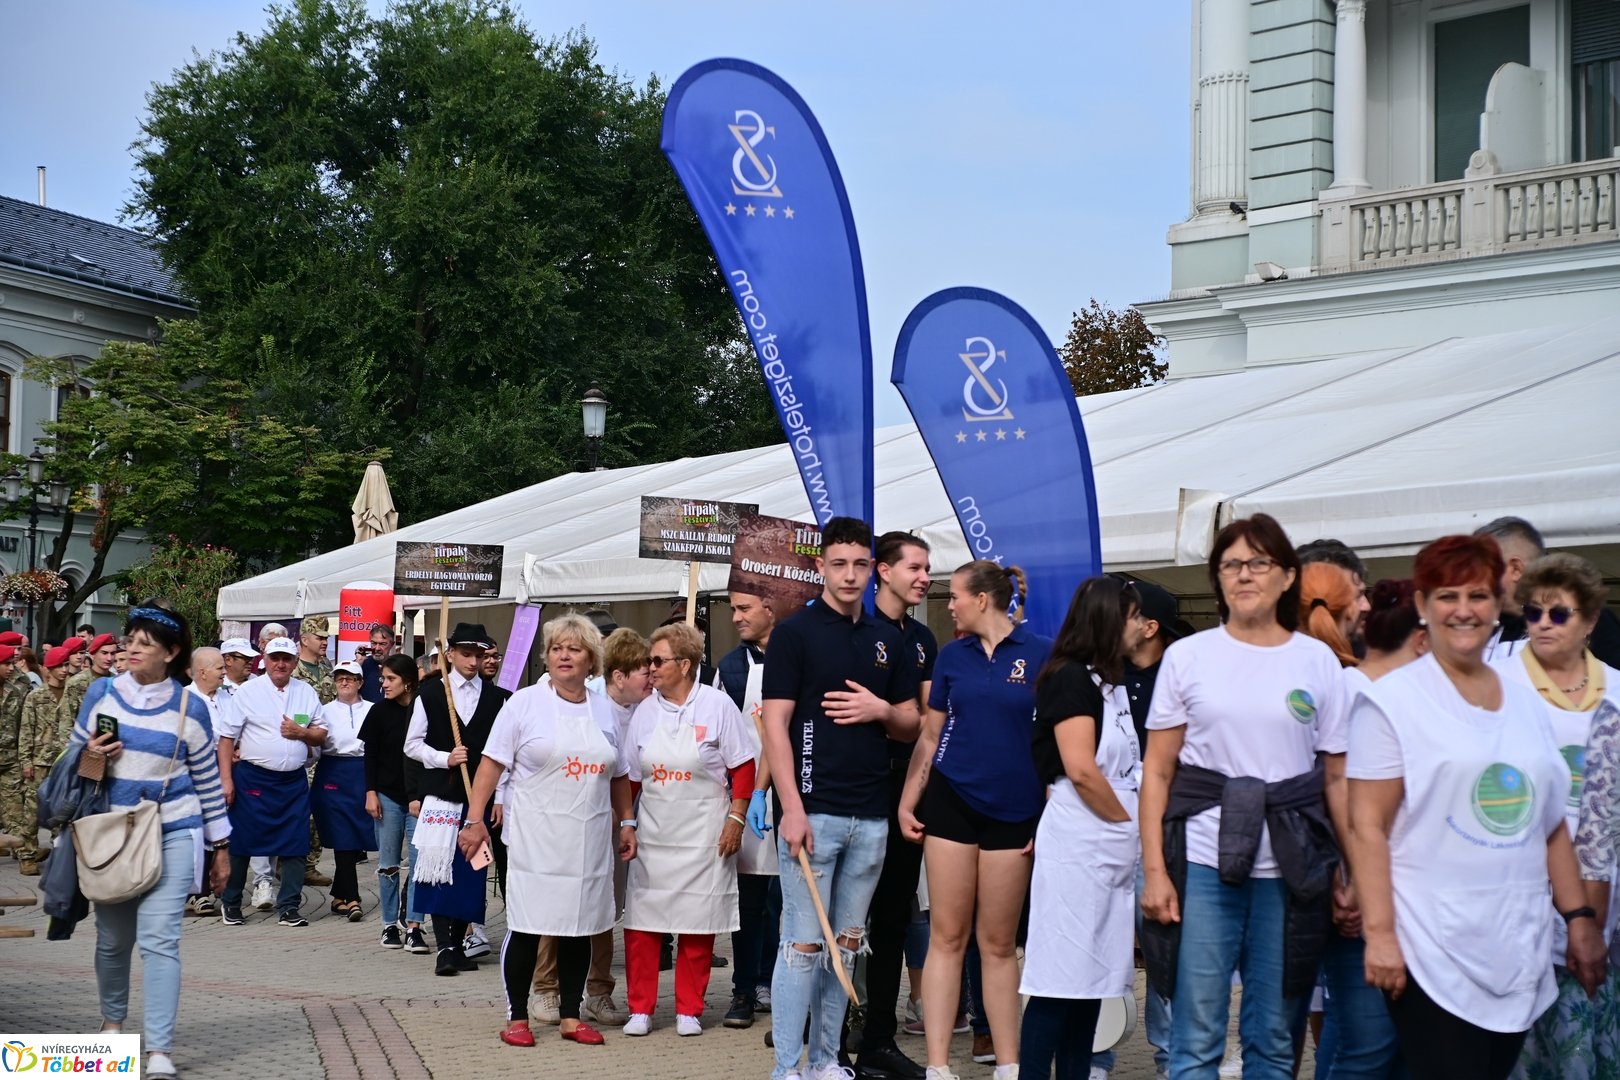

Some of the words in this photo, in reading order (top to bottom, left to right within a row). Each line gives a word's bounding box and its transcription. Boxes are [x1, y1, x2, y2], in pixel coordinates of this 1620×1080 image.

[682, 502, 715, 517] Tirpák
[660, 529, 678, 540] MSZC
[707, 532, 736, 544] RUDOLF
[795, 528, 822, 547] Tirp
[433, 545, 465, 558] Tirpák
[705, 544, 731, 556] ISKOLA
[795, 544, 822, 555] Feszt
[741, 557, 782, 577] Orosért
[344, 605, 362, 617] Fitt
[340, 619, 379, 631] ondozó
[802, 719, 814, 756] HOTEL
[564, 758, 606, 779] Oros
[653, 766, 692, 783] Oros
[801, 757, 813, 794] SZIGET
